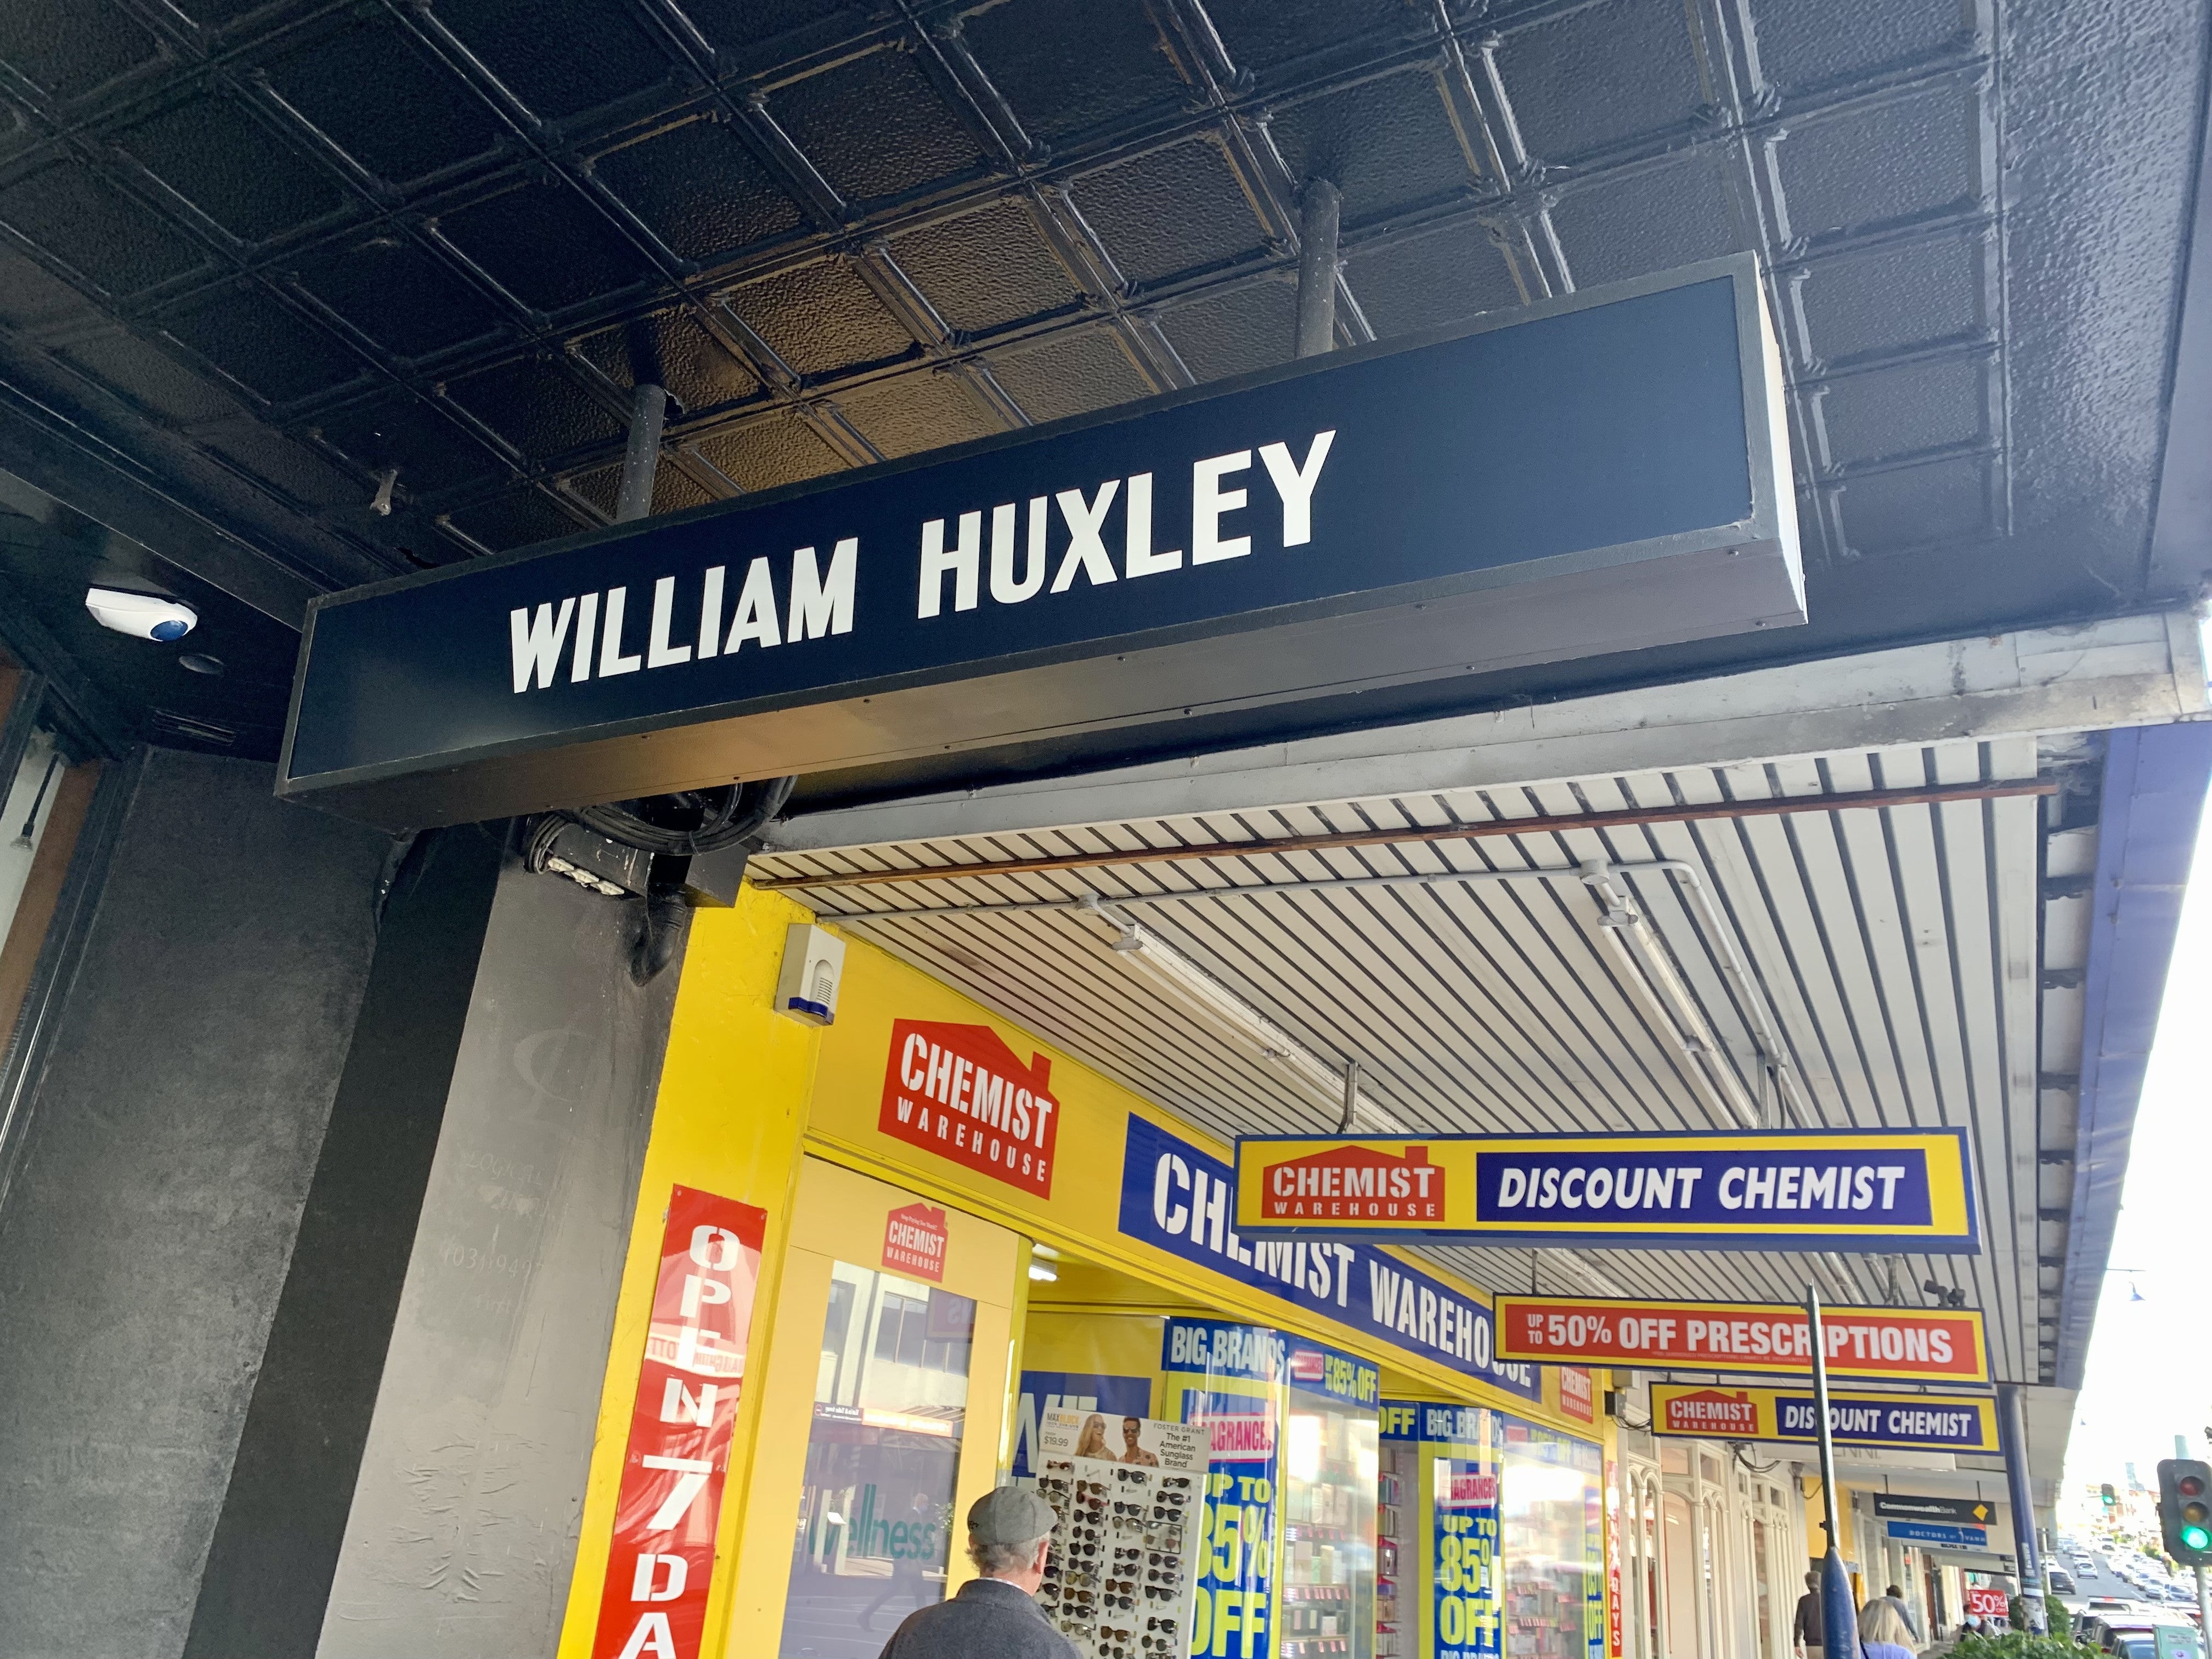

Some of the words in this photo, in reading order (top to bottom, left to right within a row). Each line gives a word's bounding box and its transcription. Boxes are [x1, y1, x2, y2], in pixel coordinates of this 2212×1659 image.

[510, 537, 859, 694] WILLIAM
[917, 430, 1336, 620] HUXLEY
[900, 1032, 1053, 1150] CHEMIST
[896, 1096, 1047, 1182] WAREHOUSE
[1273, 1166, 1435, 1198] CHEMIST
[1498, 1167, 1703, 1209] DISCOUNT
[1718, 1166, 1905, 1210] CHEMIST
[1274, 1201, 1435, 1217] WAREHOUSE
[889, 1220, 945, 1257] CHEMIST
[887, 1246, 940, 1273] WAREHOUSE
[659, 1225, 740, 1427] OPEN
[1369, 1260, 1531, 1388] WAREHO
[1527, 1313, 1544, 1328] UP
[1171, 1325, 1207, 1365] BIG
[1212, 1329, 1286, 1373] BRANDS
[1528, 1330, 1543, 1345] TO
[1548, 1314, 1612, 1347] 50%
[1619, 1317, 1677, 1350] OFF
[1686, 1319, 1954, 1363] PRESCRPTIONS
[1333, 1357, 1357, 1398] 85%
[1357, 1366, 1376, 1404] OFF
[1561, 1366, 1591, 1402] CHEMIST
[1379, 1406, 1416, 1435] OFF
[1426, 1408, 1453, 1437] BIG
[1457, 1411, 1503, 1443] BRADS
[1671, 1401, 1752, 1421] CHEMIST
[1673, 1420, 1754, 1431] WAREHOUSE
[1785, 1405, 1882, 1432] DISOUNT
[1887, 1409, 1972, 1437] CHEMIST
[1044, 1436, 1069, 1447] $19.99
[1154, 1423, 1179, 1432] FOSTER
[1181, 1426, 1205, 1435] GRANT
[1166, 1432, 1180, 1441] The
[1193, 1419, 1273, 1452] AGRANCES
[1159, 1441, 1196, 1452] American
[1160, 1449, 1193, 1460] Sunglass
[1165, 1458, 1188, 1468] Brand
[642, 1455, 714, 1531] 7
[1237, 1476, 1271, 1503] TO
[1451, 1477, 1496, 1500] AGRANCES
[1442, 1515, 1474, 1533] UP
[1475, 1517, 1497, 1536] TO
[1971, 1593, 2005, 1613] 50%
[1440, 1595, 1499, 1647] OFF
